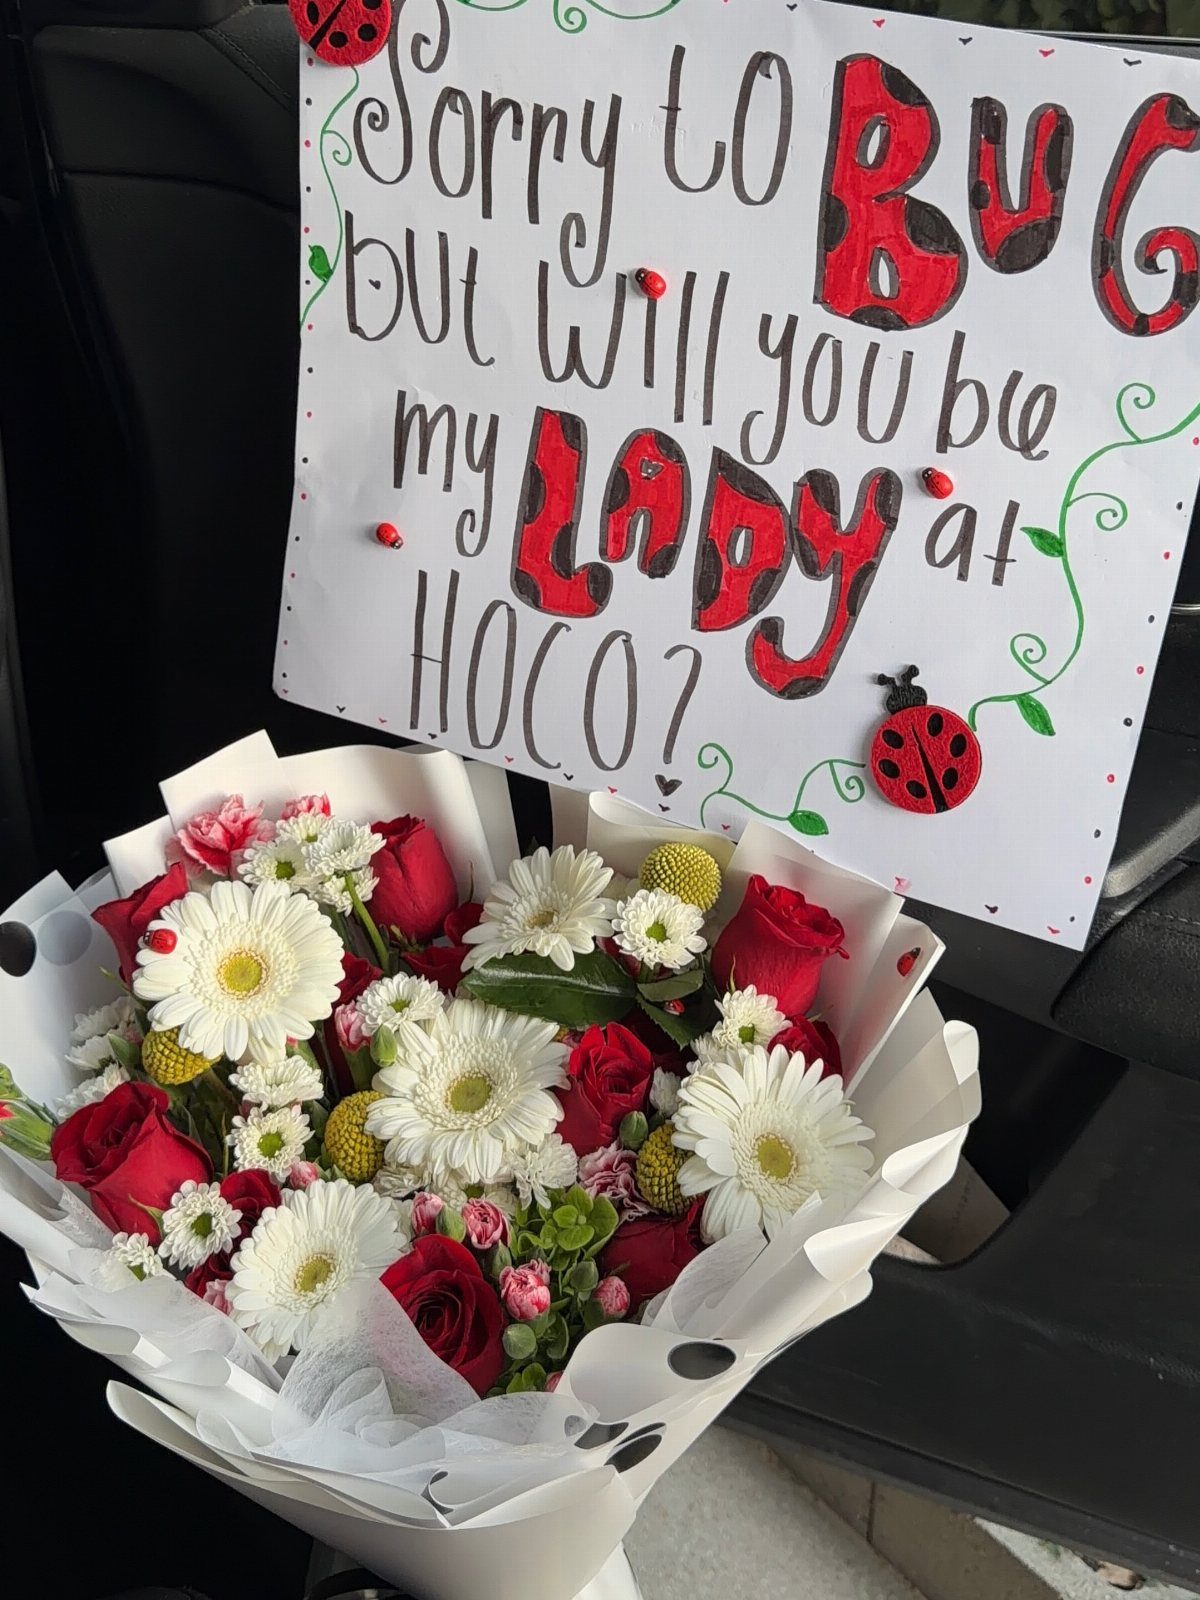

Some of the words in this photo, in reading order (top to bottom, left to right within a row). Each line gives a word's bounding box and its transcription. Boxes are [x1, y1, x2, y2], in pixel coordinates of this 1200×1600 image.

[353, 0, 623, 288] Sorry
[658, 44, 793, 206] to
[812, 52, 1200, 337] BUG
[345, 209, 496, 366] but
[538, 260, 730, 426] will
[740, 312, 914, 465] you
[936, 330, 1057, 460] be
[393, 389, 499, 557] my
[924, 499, 1020, 586] at
[410, 569, 702, 771] HOCO?
